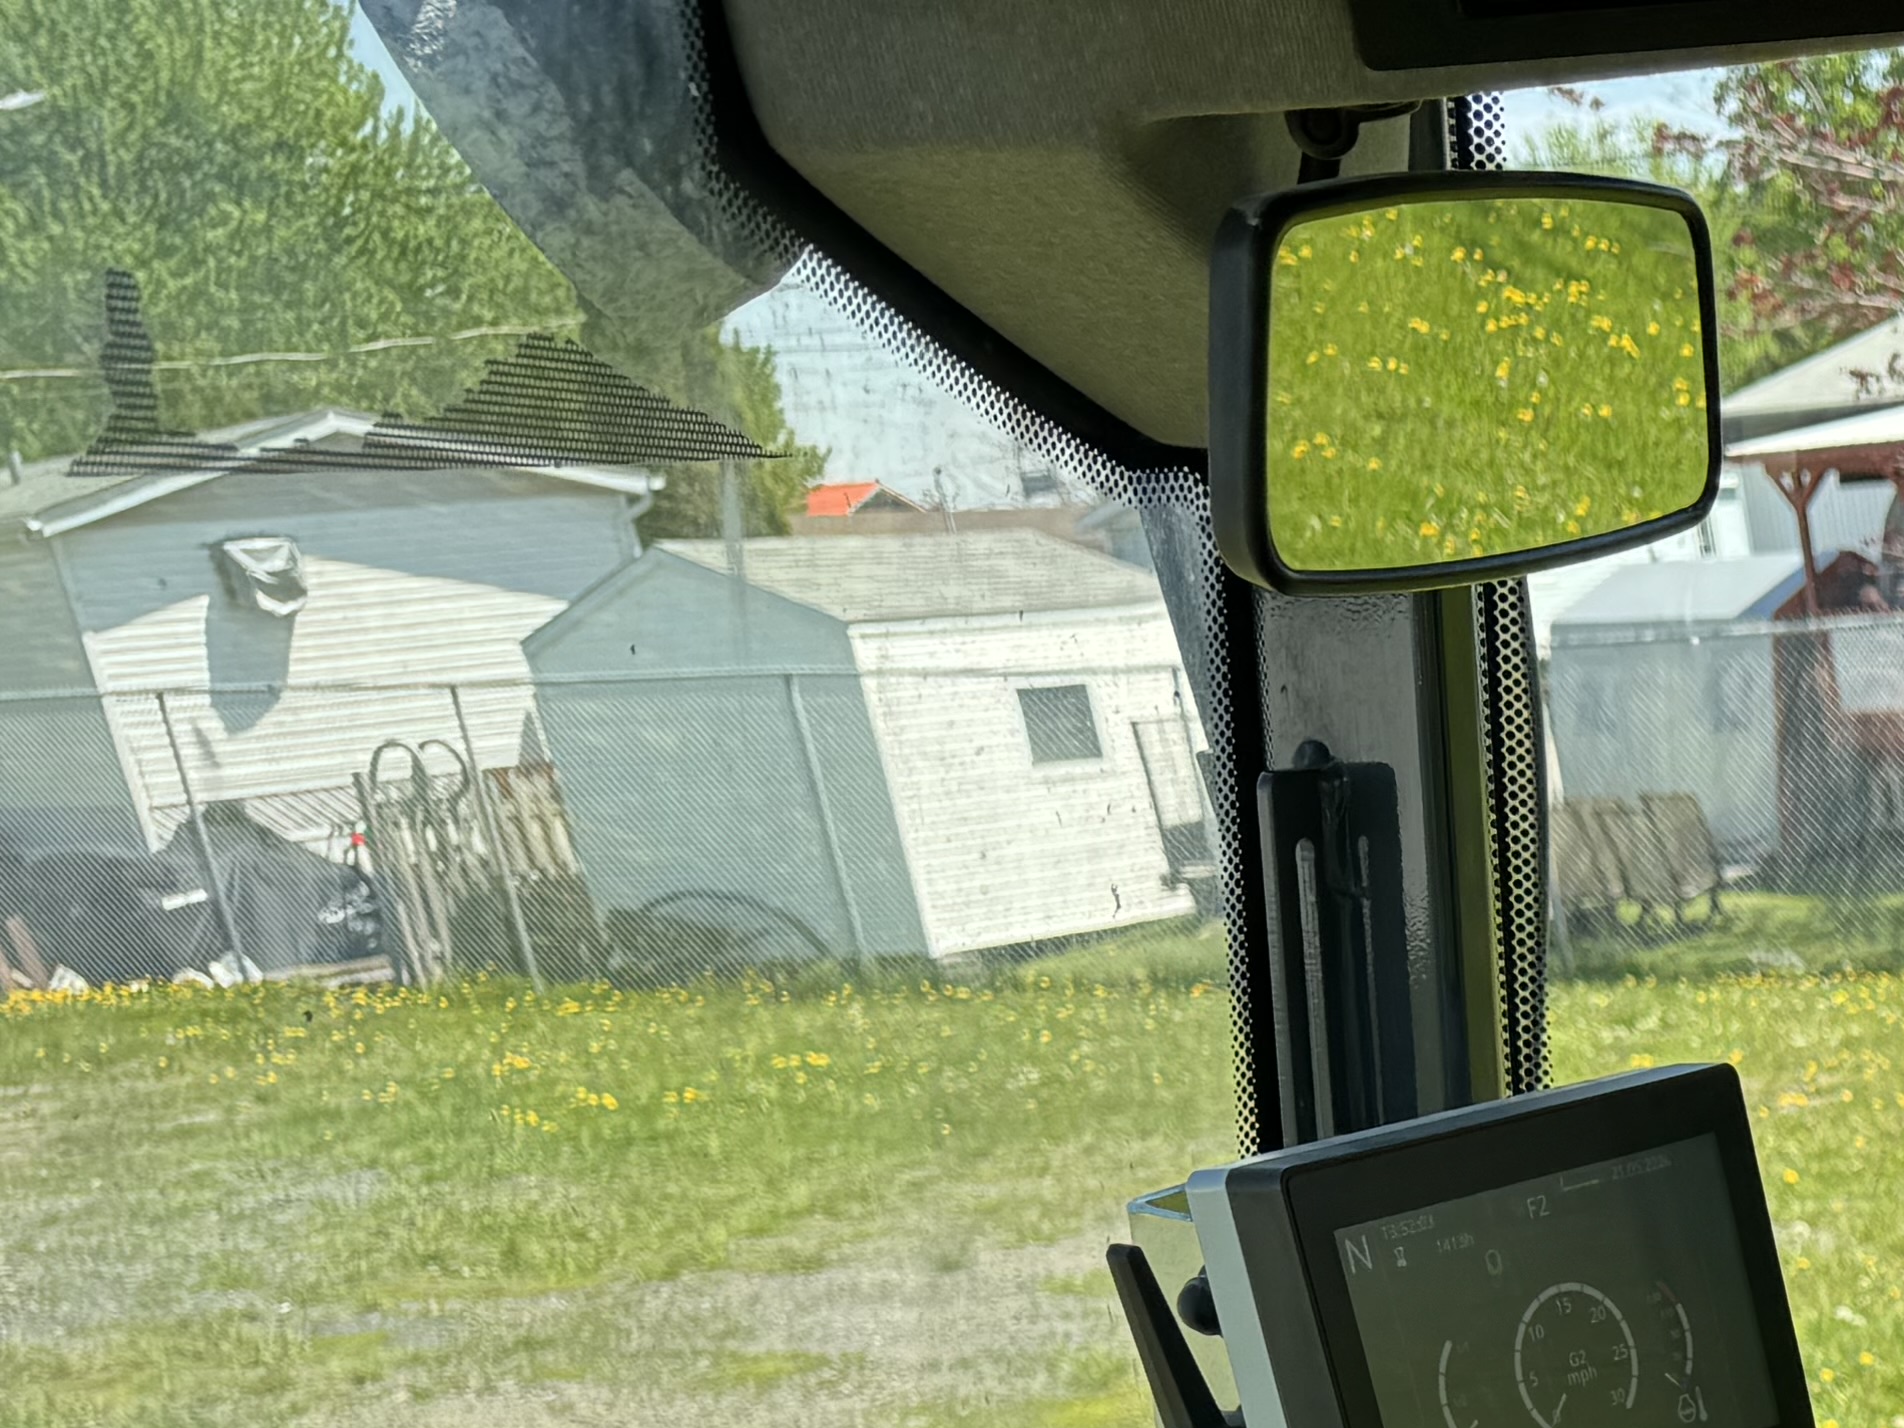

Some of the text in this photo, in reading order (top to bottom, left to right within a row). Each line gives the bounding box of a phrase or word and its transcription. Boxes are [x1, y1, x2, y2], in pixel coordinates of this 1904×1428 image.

[1526, 1194, 1551, 1220] F2
[1344, 1234, 1374, 1275] N
[1555, 1297, 1573, 1316] 15
[1589, 1305, 1607, 1323] 20
[1528, 1323, 1546, 1342] 10
[1568, 1350, 1587, 1367] G2
[1612, 1343, 1629, 1361] 25
[1528, 1370, 1539, 1388] 5
[1567, 1365, 1598, 1387] mph
[1610, 1388, 1626, 1406] 30
